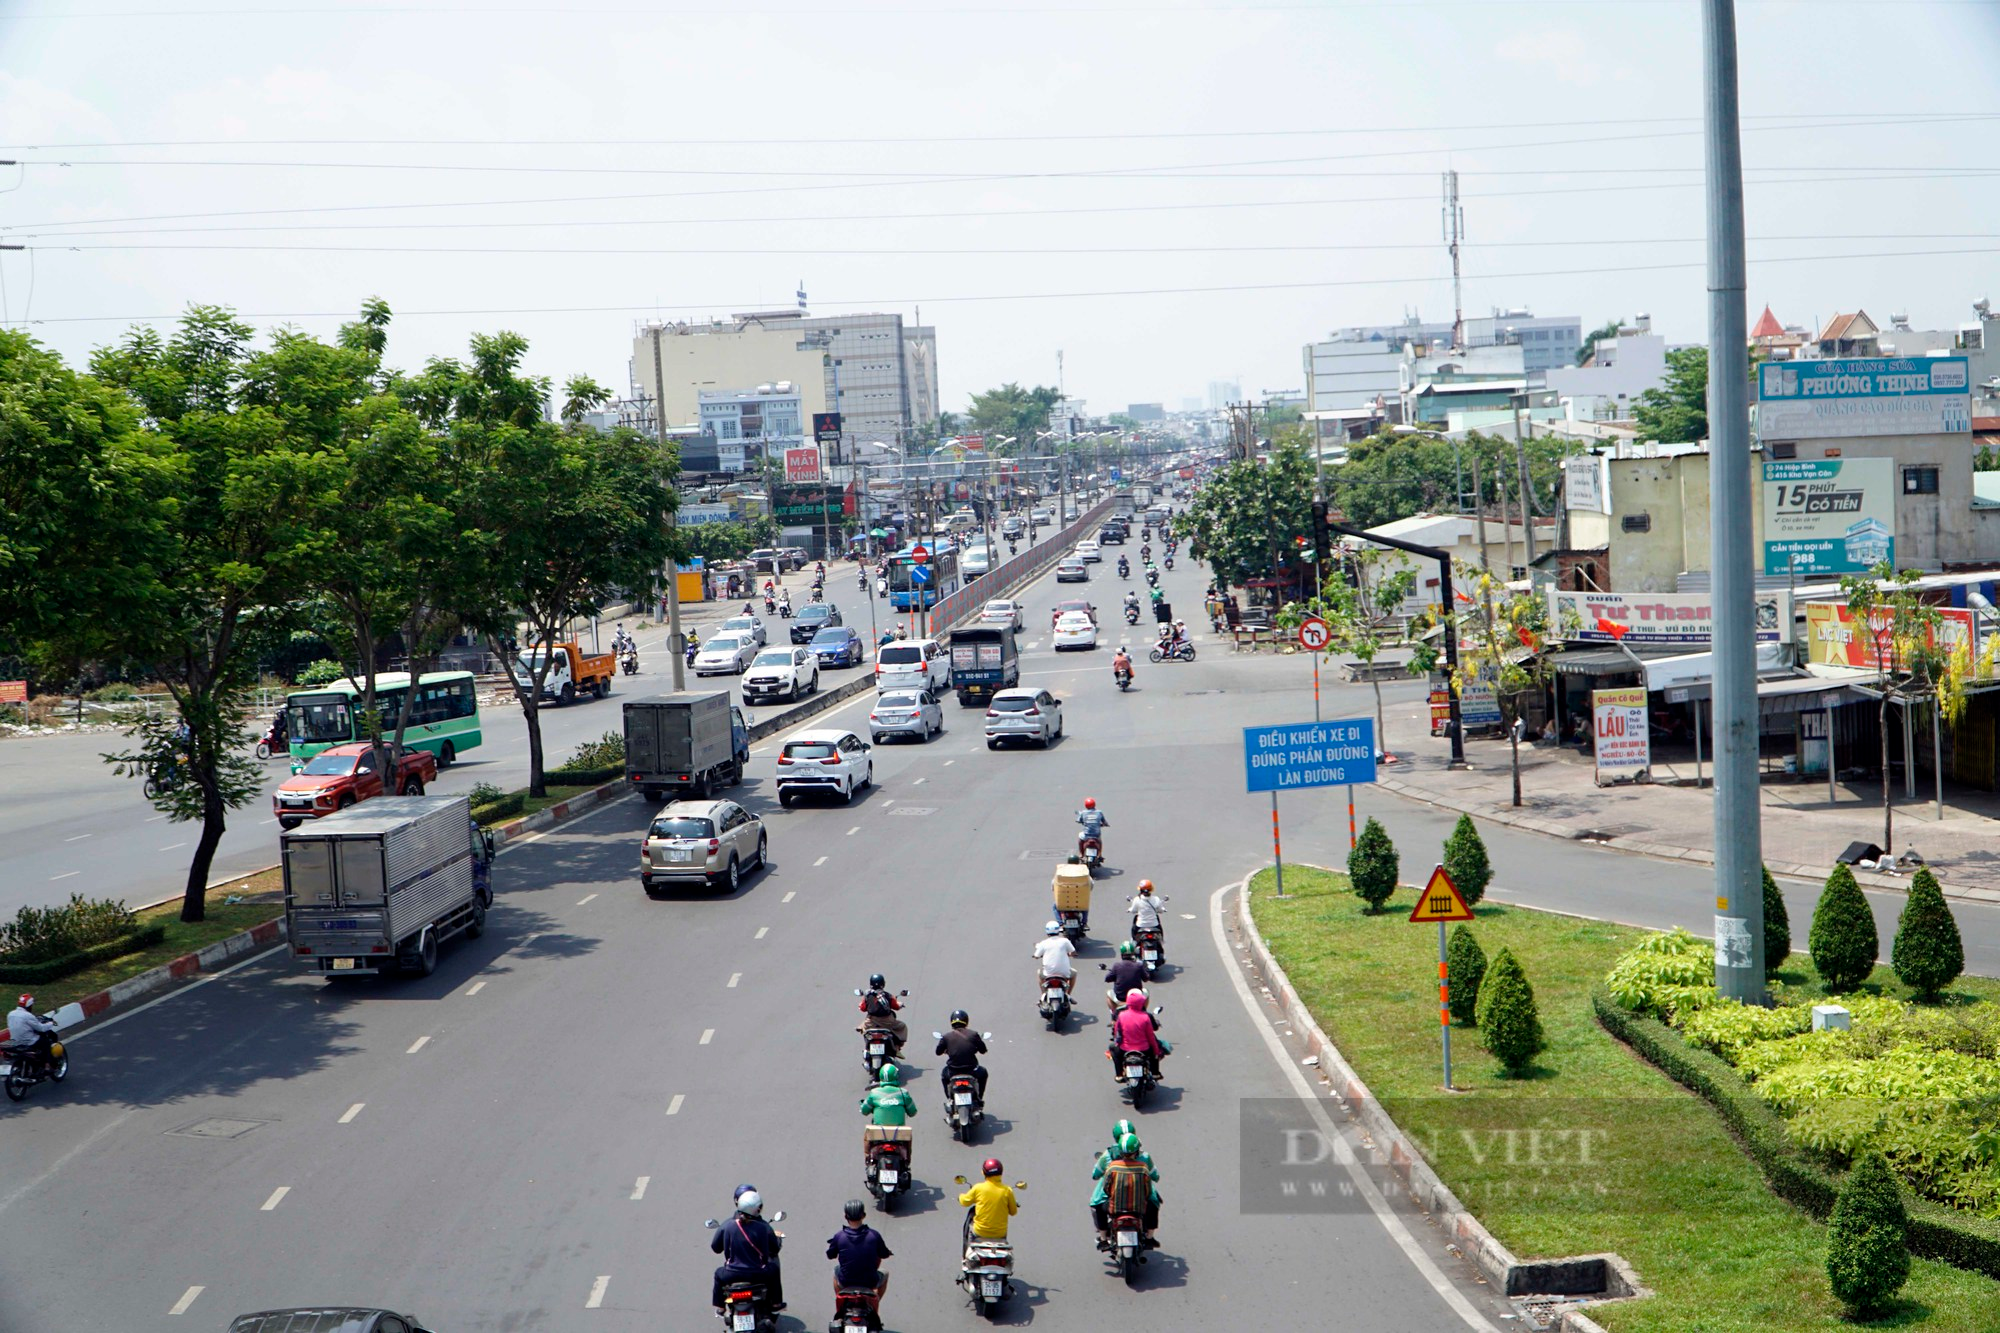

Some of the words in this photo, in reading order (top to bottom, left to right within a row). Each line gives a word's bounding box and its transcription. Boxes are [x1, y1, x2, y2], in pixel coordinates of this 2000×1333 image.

[1815, 360, 1844, 373] CỬA
[1847, 359, 1886, 372] HÀNG
[1889, 359, 1916, 371] SỮA
[1802, 374, 1872, 395] PHƯƠNG
[1875, 374, 1929, 395] THỊNH
[790, 451, 815, 466] MẮT
[790, 467, 818, 481] KÍNH
[1809, 482, 1837, 492] PHÚT
[1777, 485, 1807, 506] 15
[1809, 498, 1830, 510] CÓ
[1833, 495, 1859, 510] TIỀN
[816, 504, 841, 514] ĐNG
[1771, 543, 1787, 552] CẦN
[1788, 542, 1803, 551] TIỀN
[1804, 543, 1818, 551] GỌI
[1819, 541, 1834, 550] LIỀN
[1586, 603, 1630, 620] Tư
[1635, 603, 1711, 621] Than
[1598, 695, 1617, 704] Quán
[1598, 708, 1624, 737] LẨU
[1259, 729, 1286, 748] ĐIỀU
[1290, 726, 1326, 746] KHIỂN
[1330, 727, 1345, 742] XE
[1348, 727, 1360, 740] ĐI
[1251, 751, 1286, 768] ĐÚNG
[1290, 746, 1322, 764] PHẦN
[1326, 744, 1369, 762] ĐƯỜNG
[1279, 769, 1300, 785] LÀN
[1304, 766, 1345, 783] ĐƯỜNG
[881, 1097, 899, 1105] Grab
